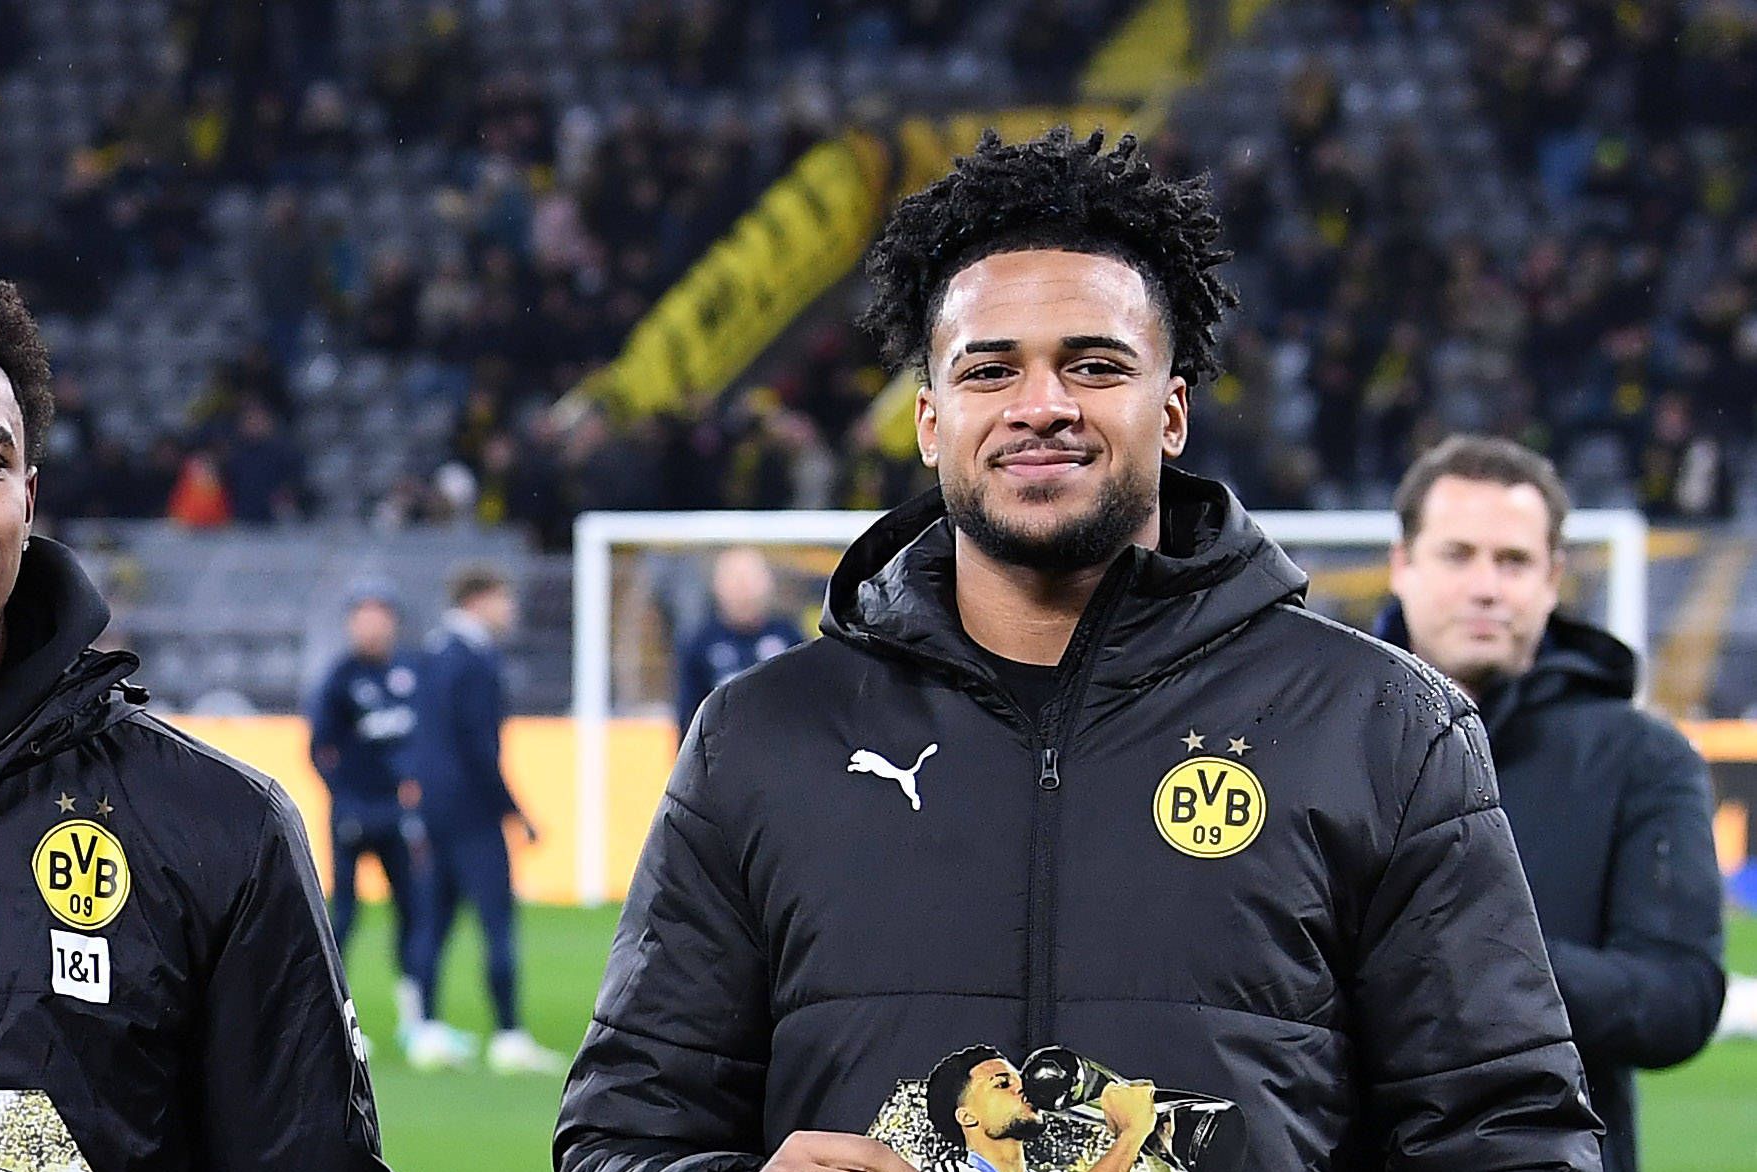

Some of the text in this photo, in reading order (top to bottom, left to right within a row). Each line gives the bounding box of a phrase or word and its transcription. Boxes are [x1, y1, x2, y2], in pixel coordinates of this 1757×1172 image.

[1171, 769, 1252, 827] BVB
[1193, 825, 1222, 845] 09
[49, 833, 118, 899] BVB
[69, 894, 94, 918] 09
[56, 947, 100, 984] 1&1
